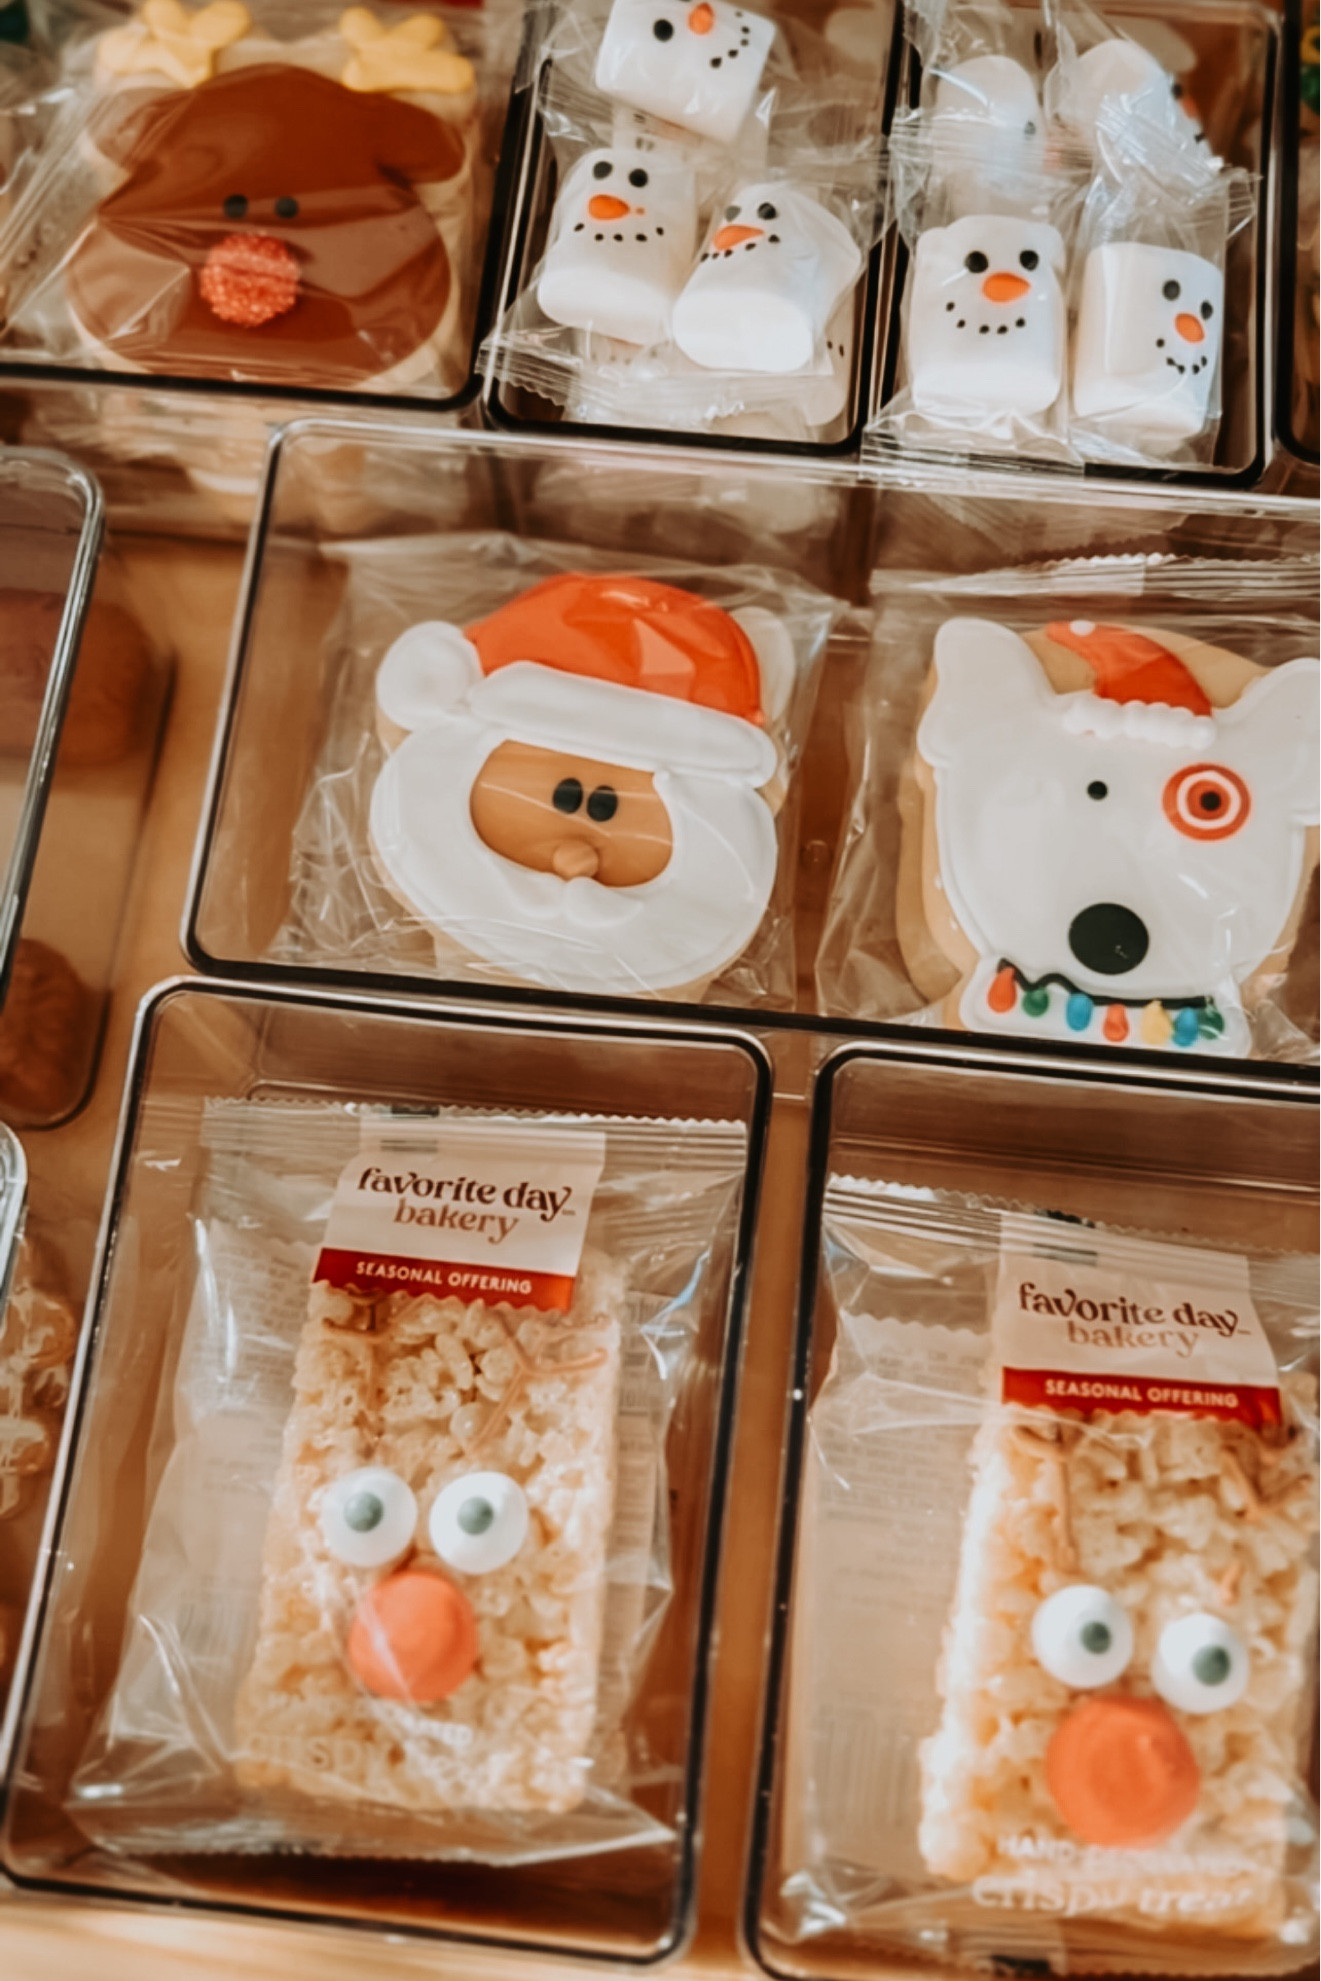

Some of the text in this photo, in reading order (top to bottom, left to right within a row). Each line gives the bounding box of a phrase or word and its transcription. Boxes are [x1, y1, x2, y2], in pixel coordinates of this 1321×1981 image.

[358, 1167, 573, 1222] favorite day
[393, 1198, 519, 1245] bakery
[356, 1261, 532, 1295] SEASONAL OFFERING
[1018, 1282, 1239, 1337] favorite day
[1067, 1320, 1199, 1357] bakery
[1045, 1379, 1239, 1408] SEASONAL OFFERING
